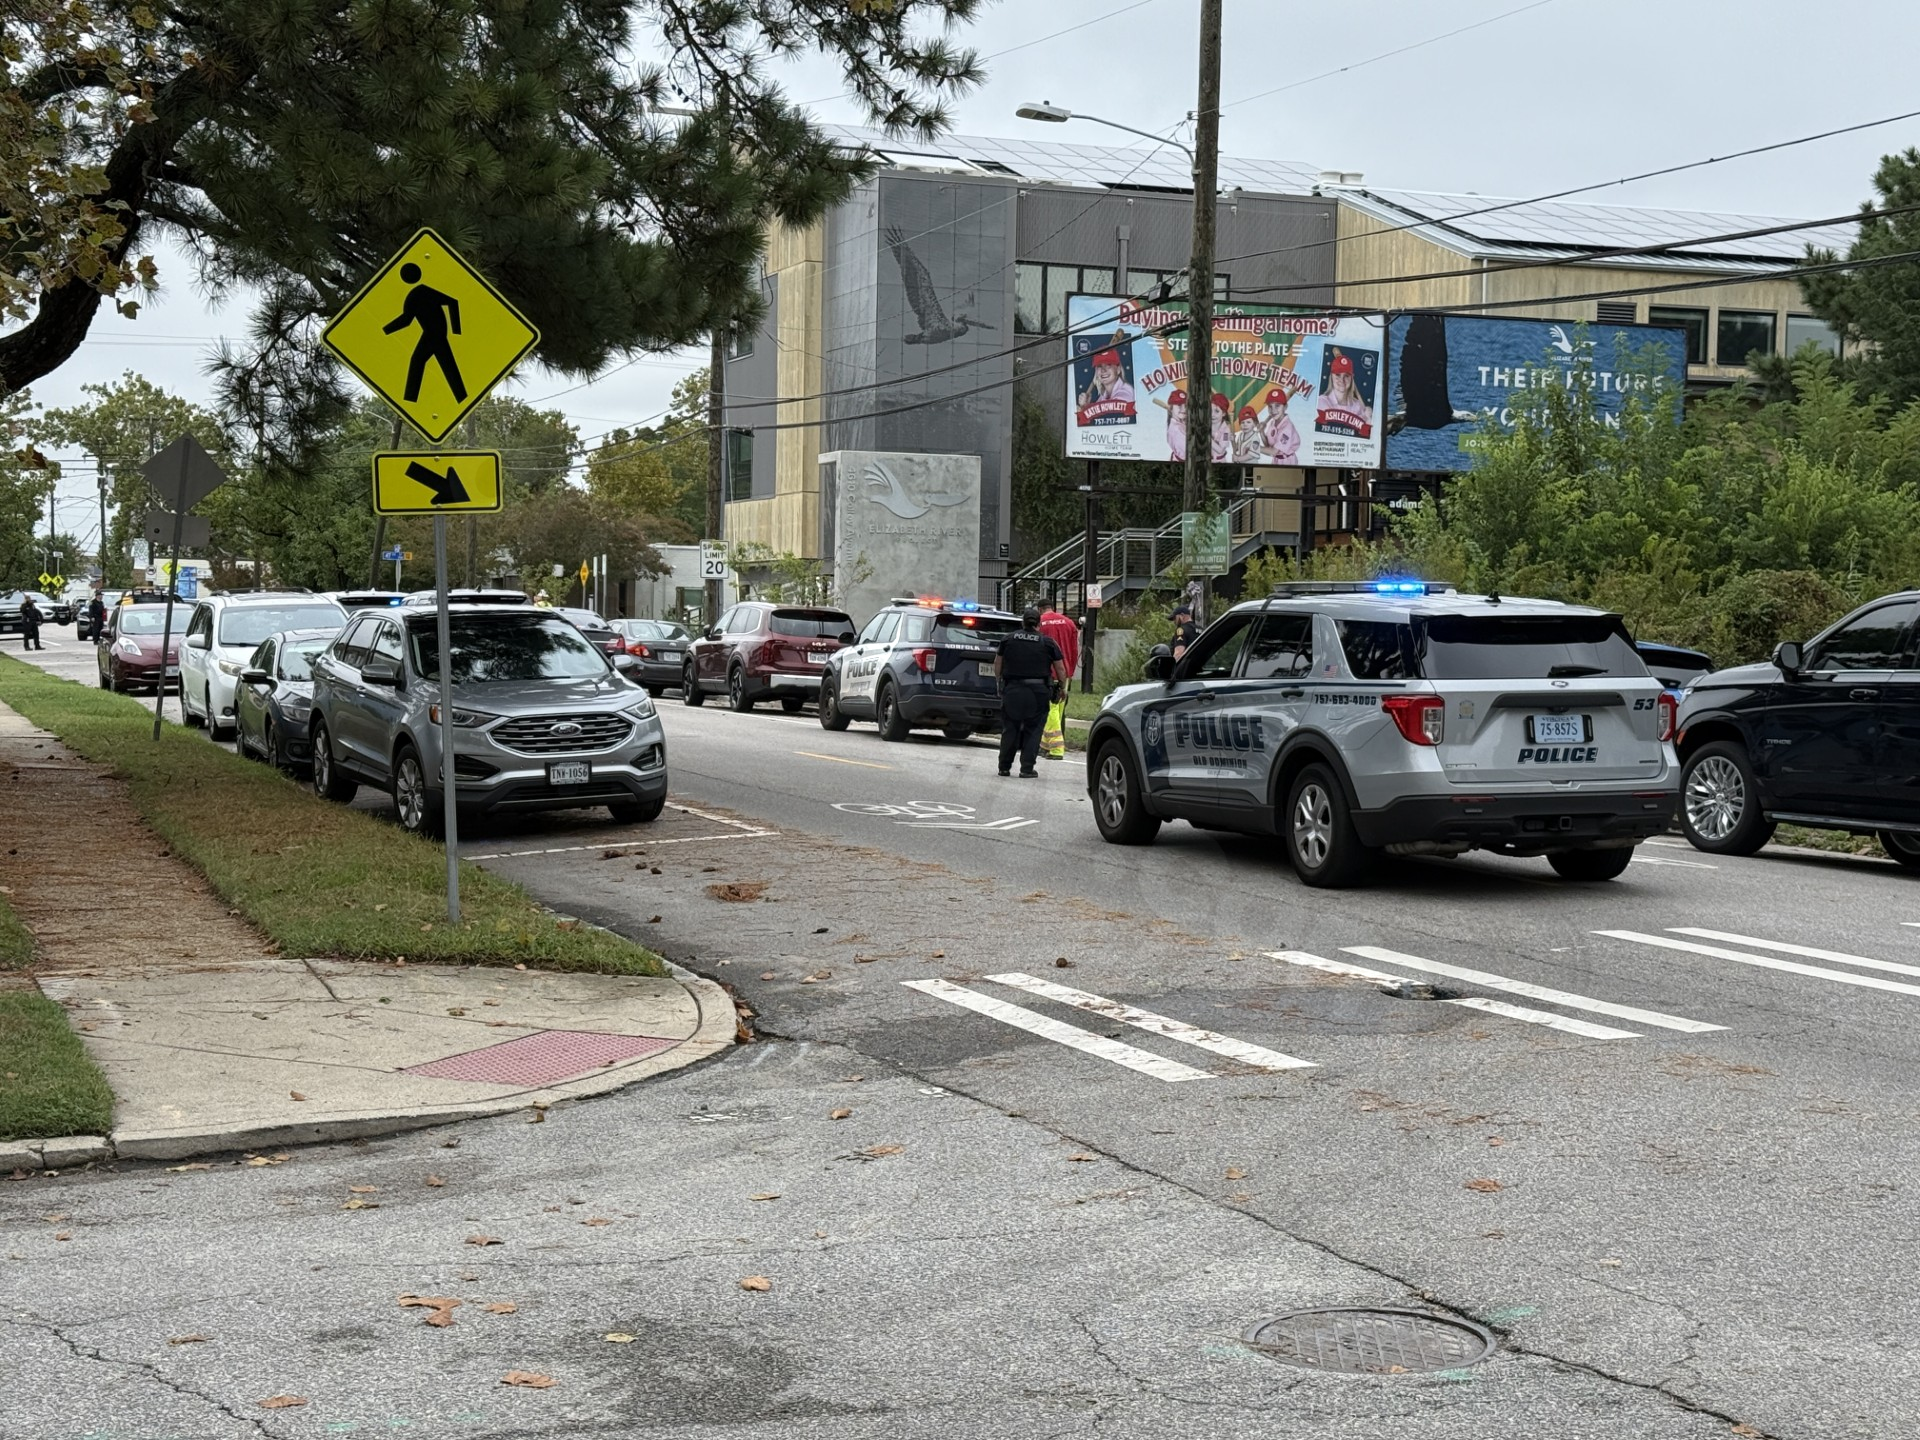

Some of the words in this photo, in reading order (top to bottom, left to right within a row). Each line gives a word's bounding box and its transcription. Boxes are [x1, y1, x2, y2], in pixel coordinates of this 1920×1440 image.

[1119, 302, 1181, 331] Buying
[1280, 315, 1340, 336] Home?
[1166, 337, 1189, 351] STE
[1214, 340, 1230, 352] TO
[1231, 341, 1253, 354] THE
[1254, 342, 1289, 356] PLATE
[1221, 356, 1269, 380] HOME
[1269, 363, 1314, 399] TEAM
[1083, 403, 1102, 419] KATIE
[1100, 400, 1128, 413] HOWLETT
[1324, 411, 1350, 423] ASHLEY
[1348, 414, 1364, 430] LINK
[1081, 433, 1132, 445] HOWLETT
[868, 523, 927, 537] ELIZABETH
[930, 526, 963, 538] RIVER
[704, 551, 725, 559] LIMIT
[705, 560, 724, 574] 20
[1013, 633, 1040, 642] POLICE
[944, 643, 981, 651] NORFOLK
[846, 656, 879, 679] POLICE
[1632, 698, 1656, 711] 53
[1172, 711, 1265, 753] POLICE
[1192, 755, 1208, 766] OLD
[1209, 756, 1248, 769] DOMINION
[1517, 747, 1599, 764] POLICE
